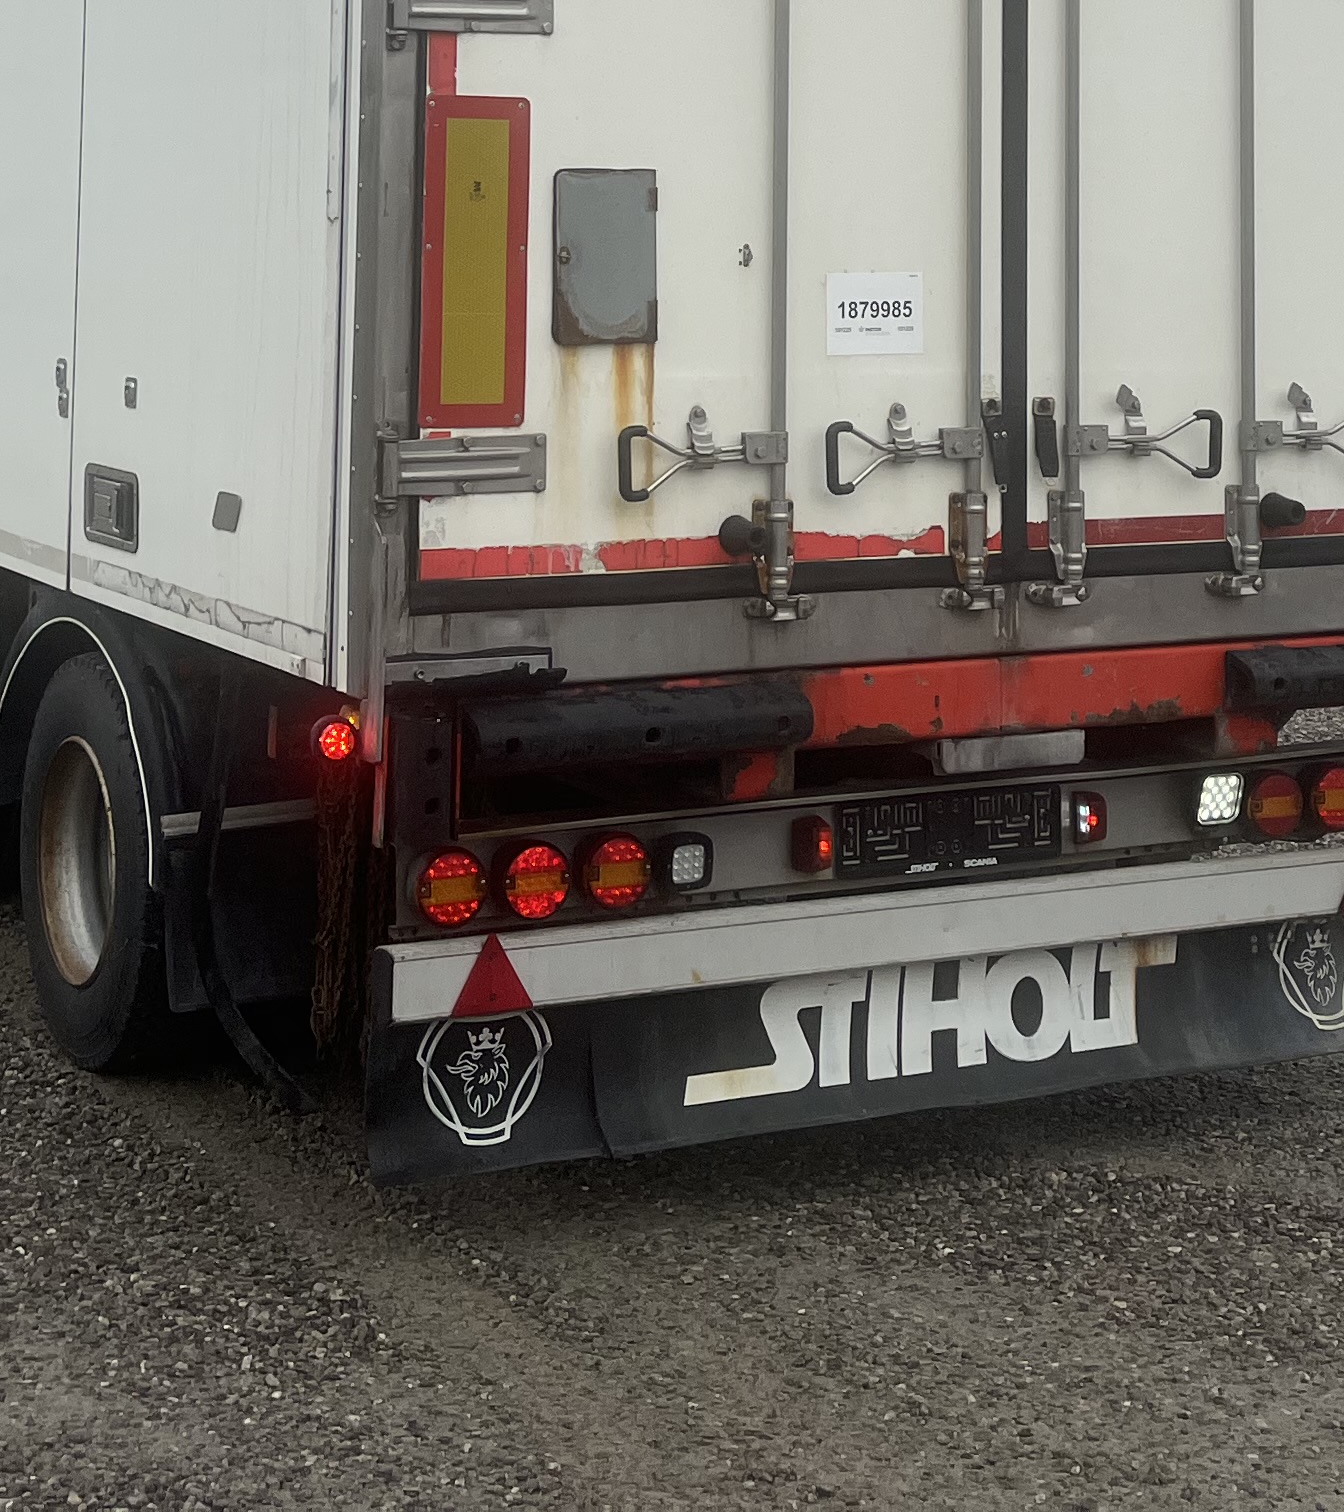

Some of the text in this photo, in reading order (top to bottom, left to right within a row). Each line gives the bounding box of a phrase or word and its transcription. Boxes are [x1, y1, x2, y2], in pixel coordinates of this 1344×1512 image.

[837, 300, 913, 319] 1879985
[963, 857, 998, 868] SCANIA
[684, 934, 1178, 1106] STIHOLT
